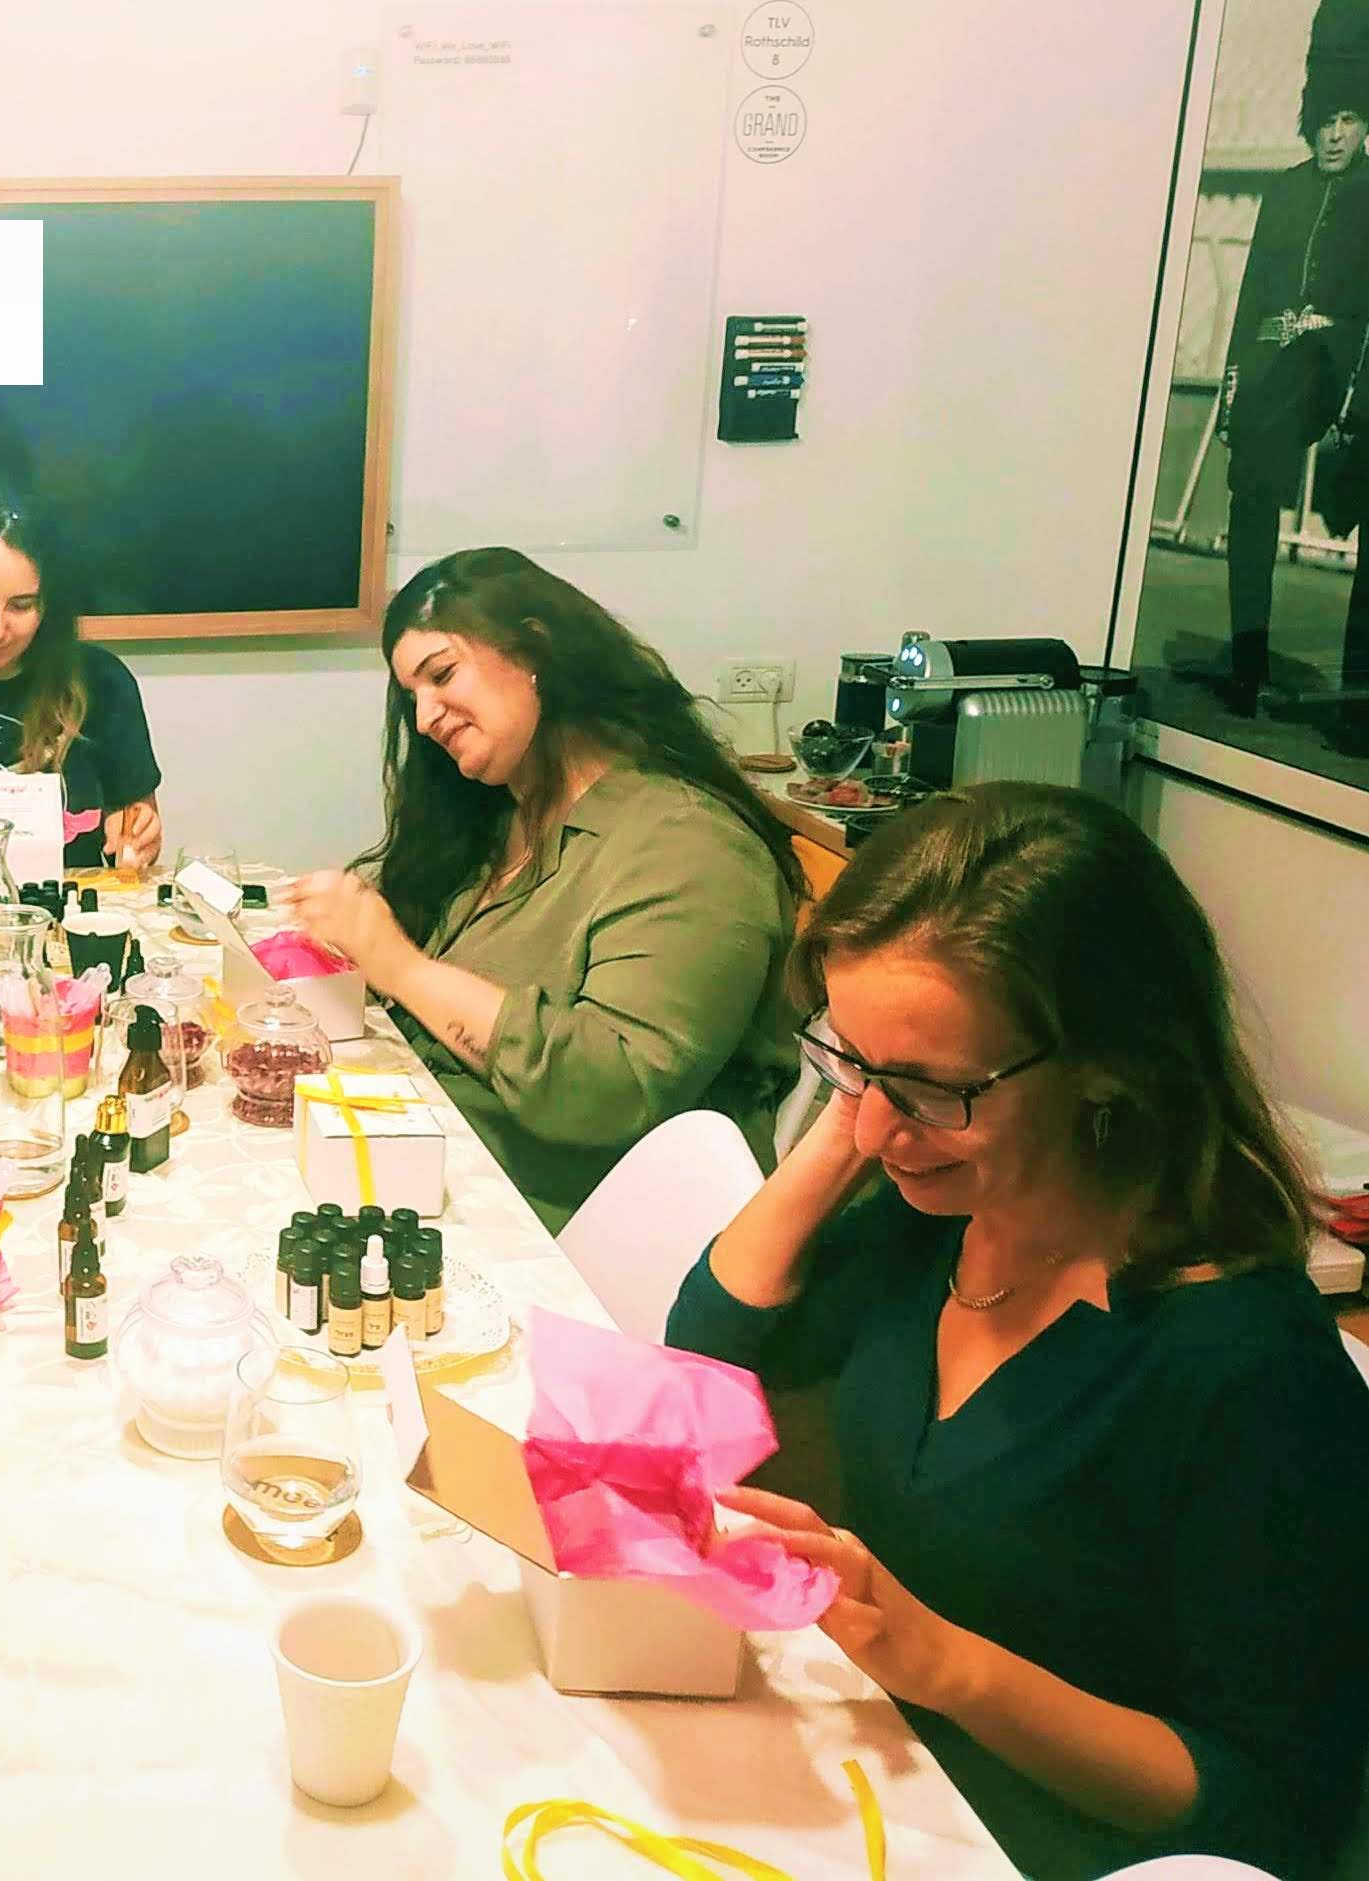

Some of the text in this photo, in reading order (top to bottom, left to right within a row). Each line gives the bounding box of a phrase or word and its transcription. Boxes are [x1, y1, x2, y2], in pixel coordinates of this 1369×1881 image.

[768, 17, 791, 29] TLV
[744, 35, 810, 47] Rothschild
[743, 113, 799, 136] GRAND
